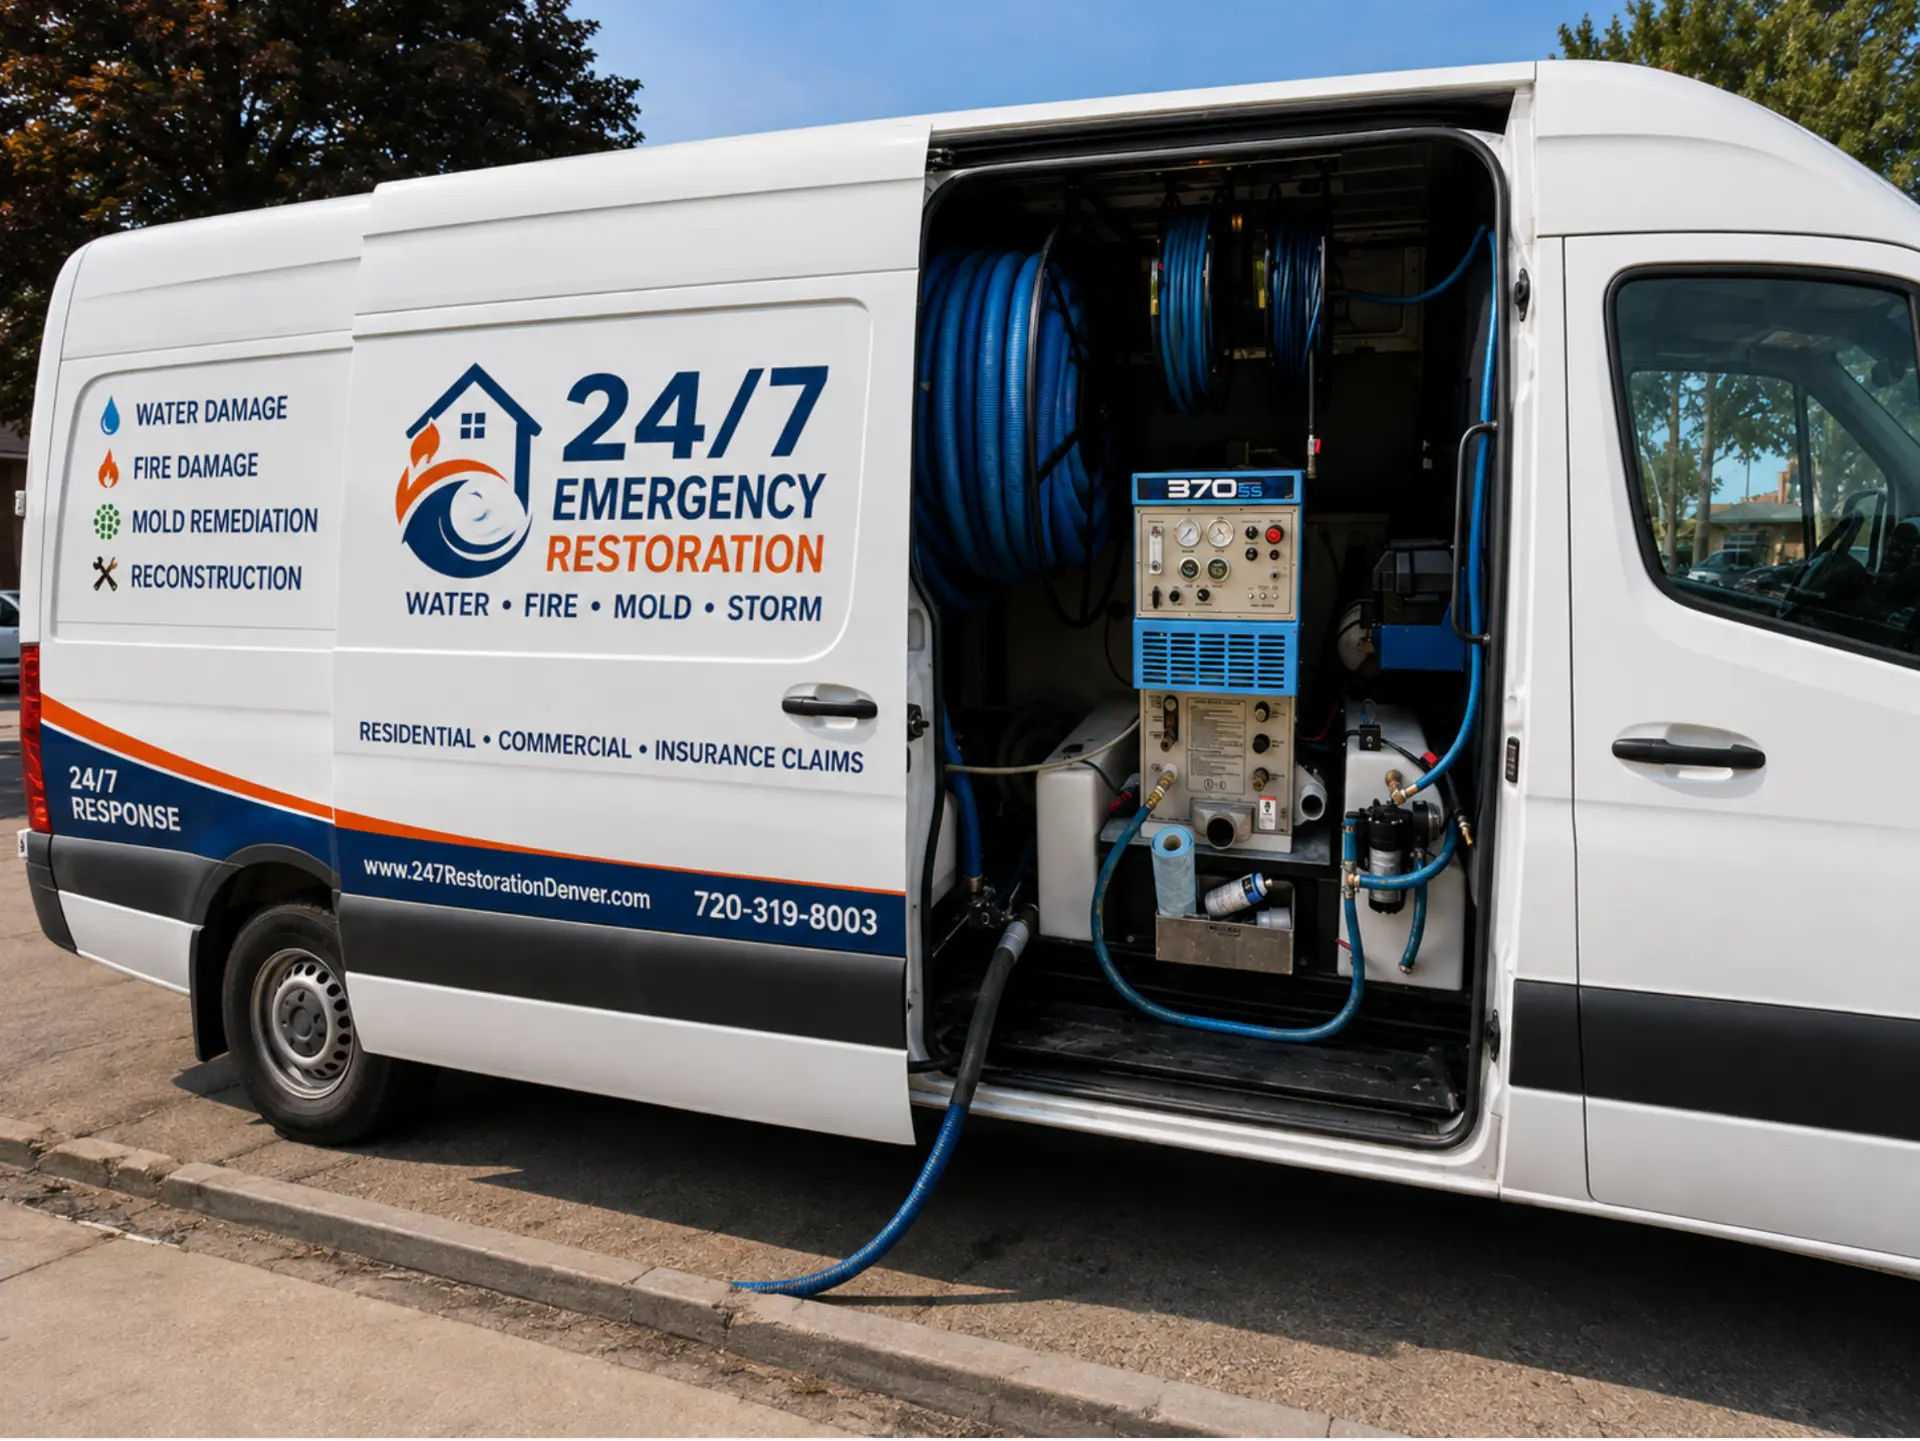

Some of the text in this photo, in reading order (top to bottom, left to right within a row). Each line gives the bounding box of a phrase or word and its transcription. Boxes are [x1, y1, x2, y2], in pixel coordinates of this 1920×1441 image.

[136, 396, 288, 426] WATER DAMAGE
[563, 365, 829, 462] 24/7
[134, 453, 258, 479] FIRE DAMAGE
[553, 473, 826, 520] EMERGENCY
[133, 508, 318, 533] MOLD REMEDIATION
[546, 534, 824, 574] RESTORATION
[132, 565, 301, 590] RECONSTRUCTION
[406, 592, 822, 621] WATER FIRE MOLD STORM
[360, 722, 863, 773] RESIDENTIAL COMMERCIAL INSURANCE CLAIMS
[70, 766, 117, 792] 24/7
[72, 797, 180, 831] RESPONSE
[364, 858, 651, 910] www.247RestorationDenver.com
[694, 890, 878, 936] 720-319-8003
